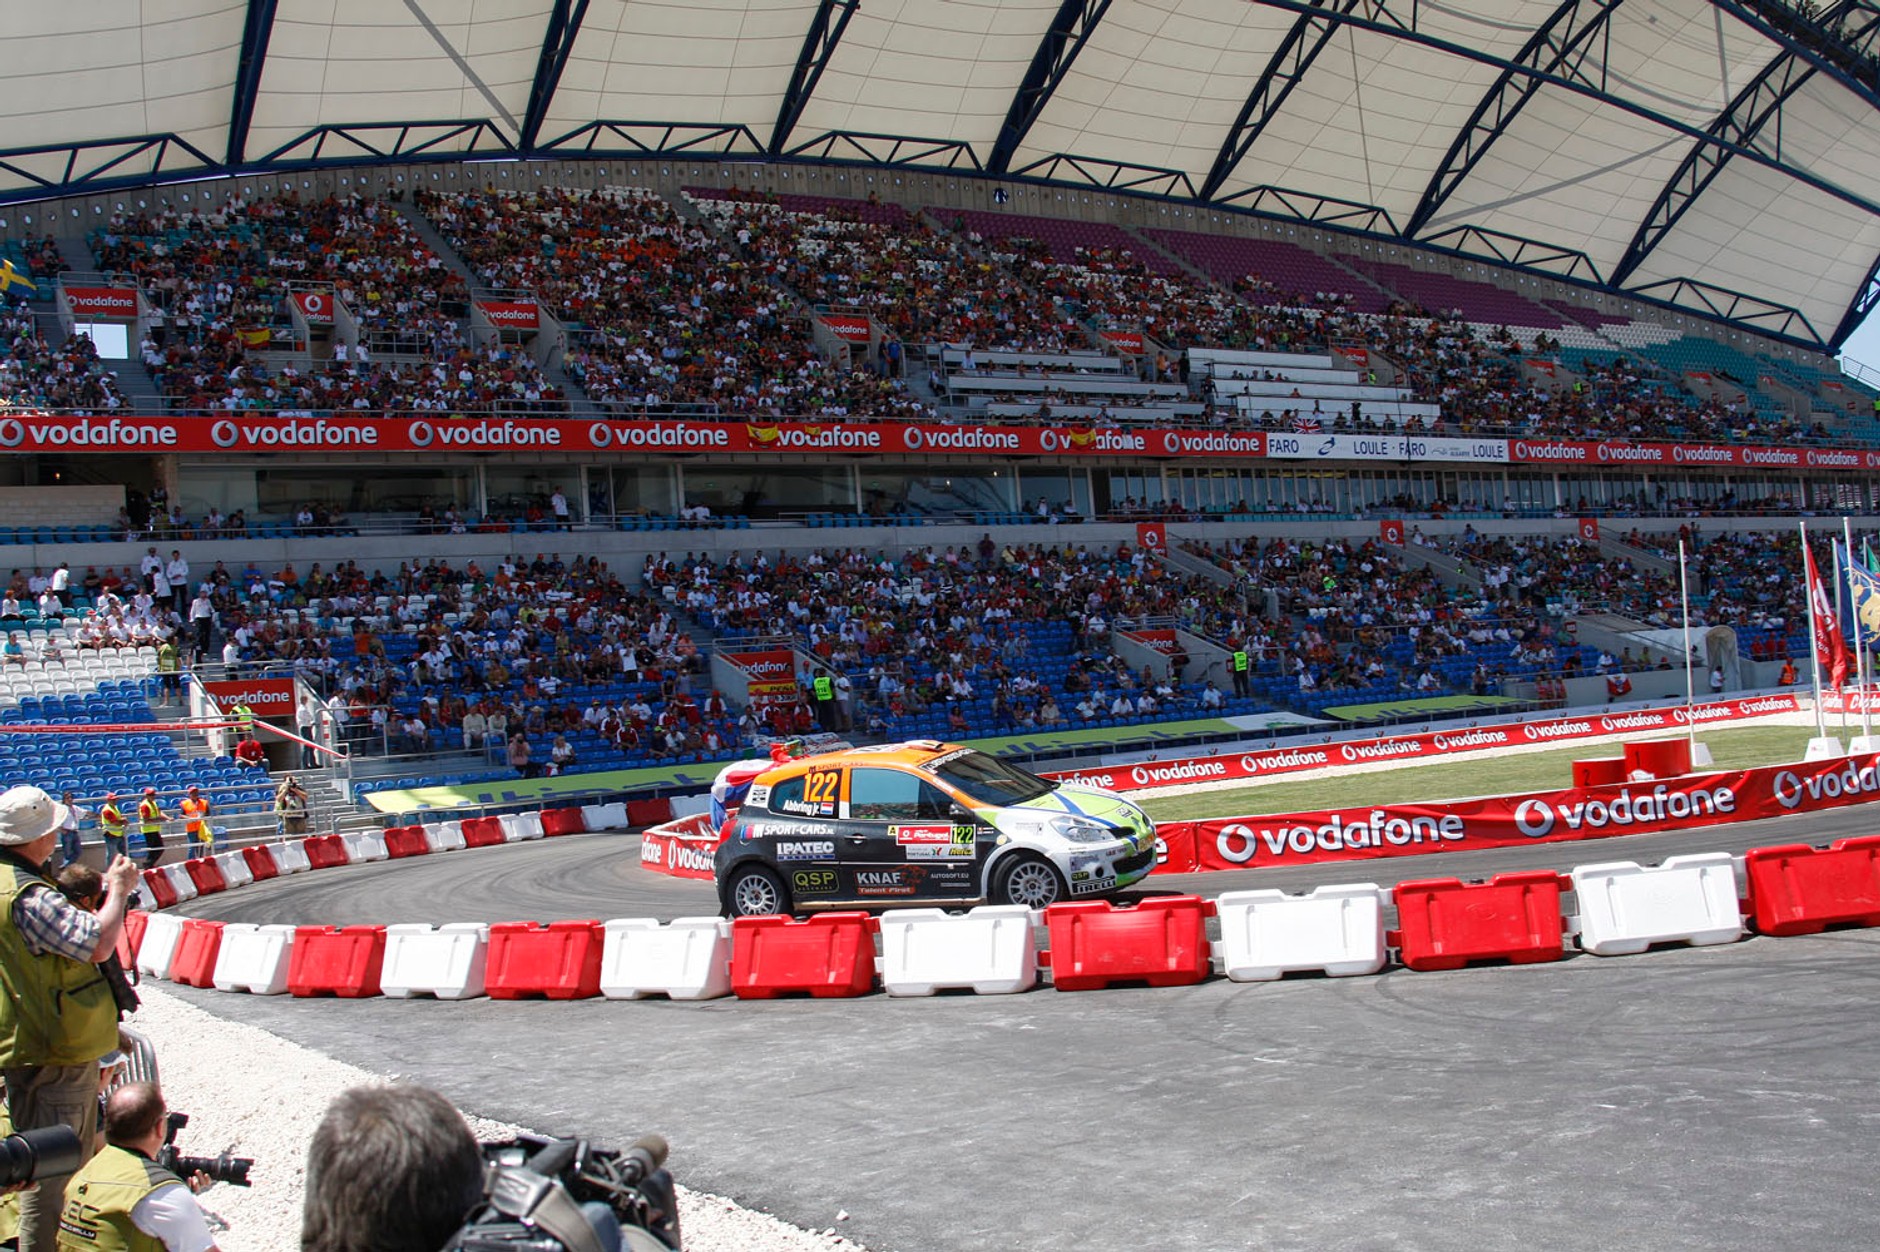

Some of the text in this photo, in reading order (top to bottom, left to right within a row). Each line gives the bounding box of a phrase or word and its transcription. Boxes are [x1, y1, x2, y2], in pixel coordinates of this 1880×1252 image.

[78, 296, 134, 307] vodafone
[490, 309, 536, 320] vodafone
[28, 418, 178, 445] vodafone
[243, 420, 378, 444] vodafone
[437, 421, 561, 446] vodafone
[615, 422, 729, 446] vodafone
[925, 428, 1019, 448] vodafone
[1182, 433, 1260, 452] vodafone
[1269, 438, 1300, 454] FARO
[1399, 441, 1426, 457] FARO
[1528, 443, 1586, 459] vodafone
[1610, 444, 1663, 460] vodafone
[1684, 446, 1733, 462] vodafone
[1753, 449, 1798, 464] vodafone
[1816, 451, 1859, 465] vodafone
[1750, 697, 1794, 711] vodafone
[1537, 720, 1592, 737] vodafone
[1612, 713, 1664, 728] vodafone
[1356, 736, 1422, 758] vodafone
[1449, 729, 1508, 748] vodafone
[1256, 750, 1329, 770] vodafone
[1148, 761, 1227, 783] vodafone
[803, 772, 839, 802] 122
[1557, 784, 1737, 829] vodafone
[952, 826, 974, 844] 122
[1260, 808, 1465, 855] vodafone
[776, 841, 835, 855] IPATEC
[795, 872, 835, 887] QSP
[856, 872, 901, 884] KNAF
[1071, 875, 1117, 894] PIRELLI
[1072, 872, 1089, 880] QSP
